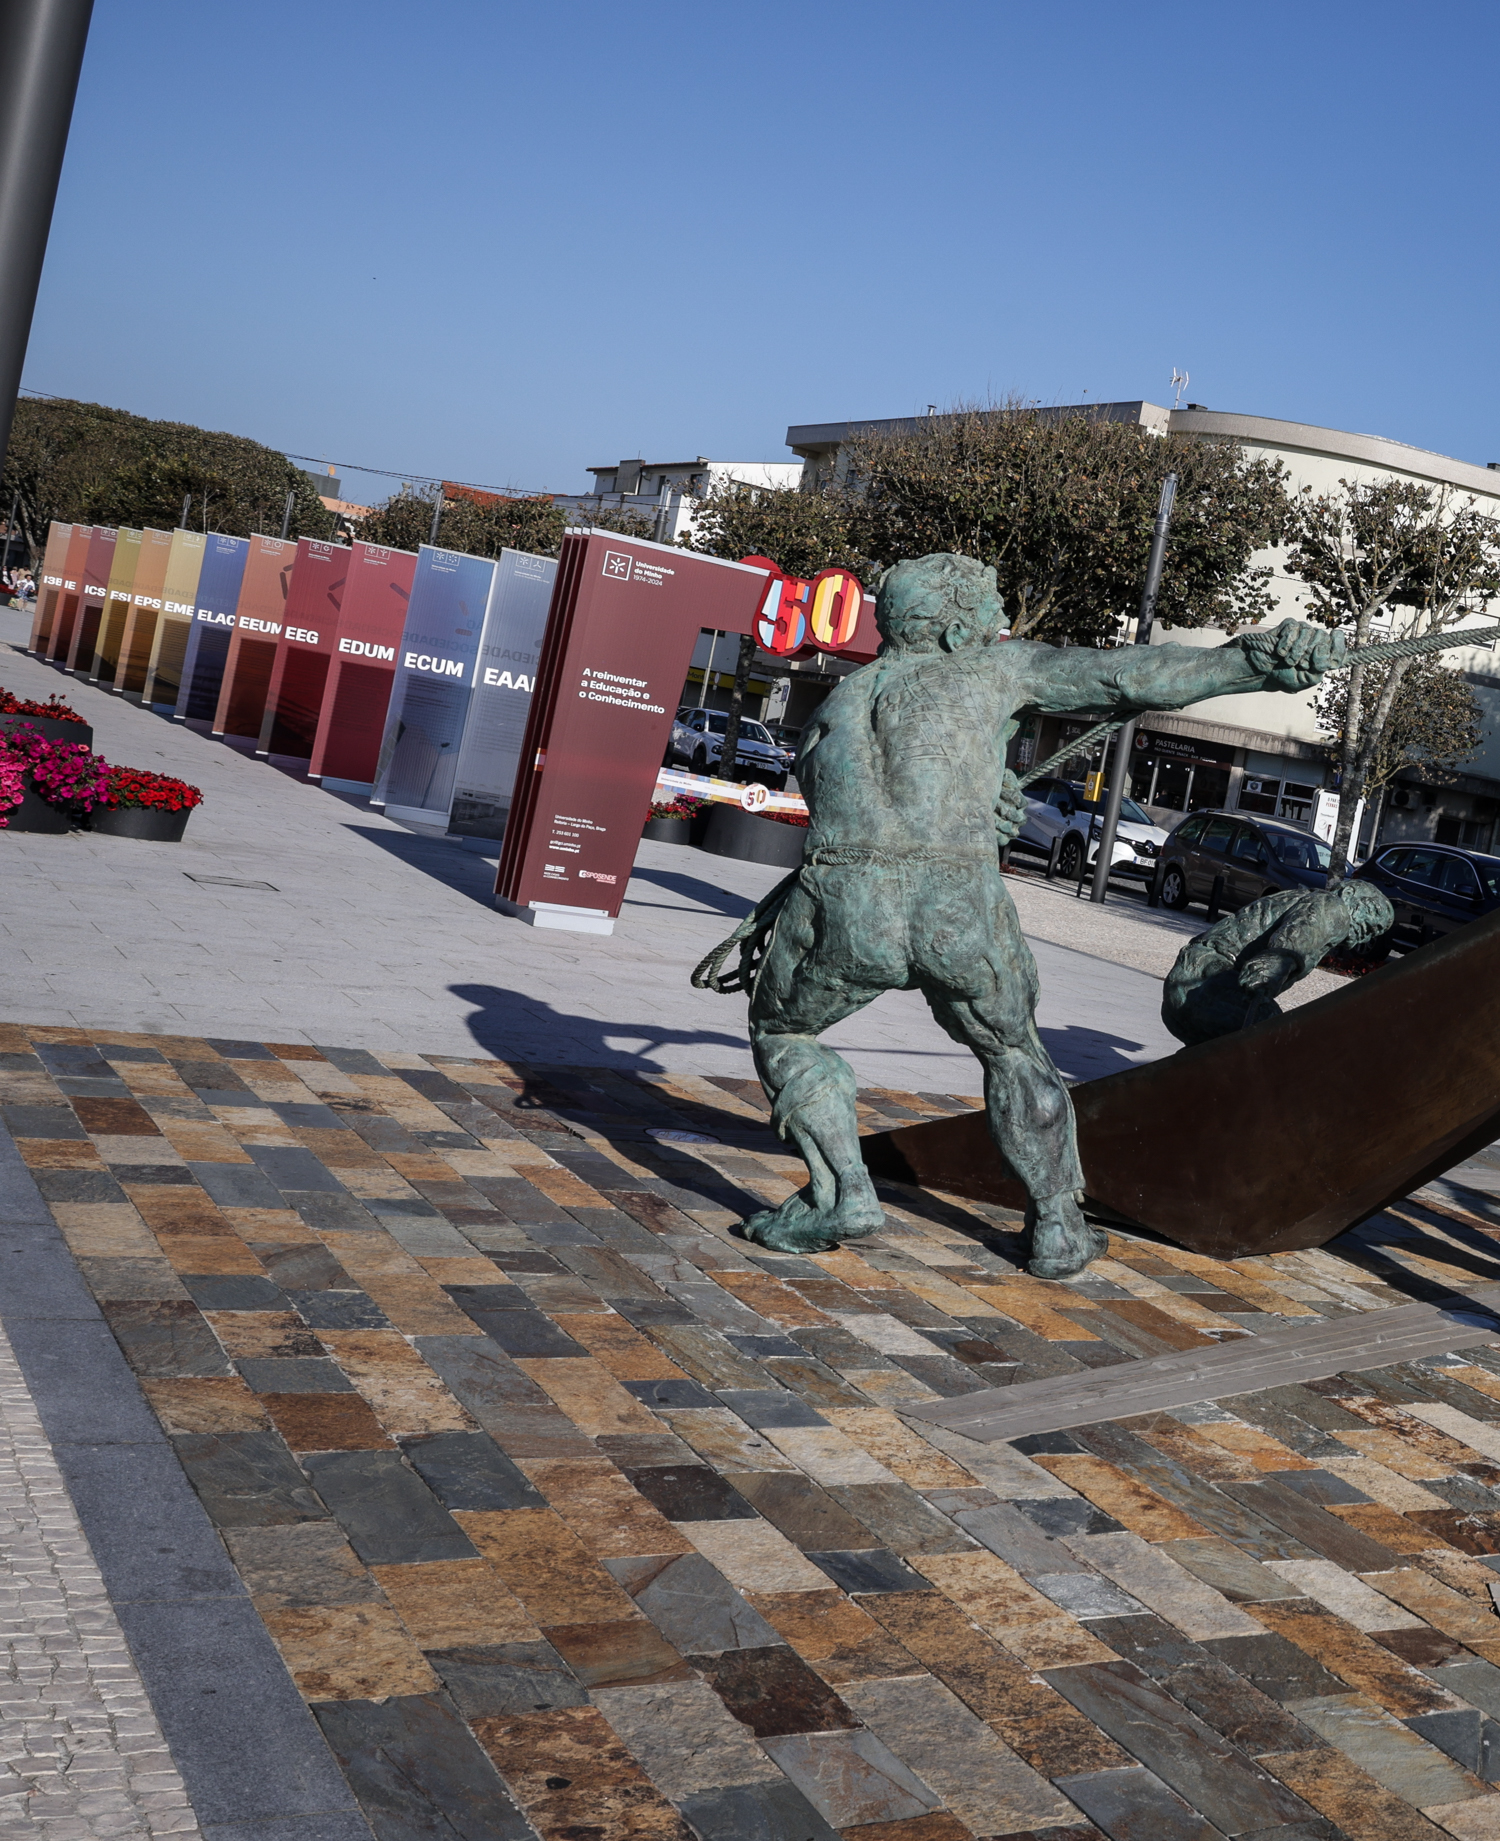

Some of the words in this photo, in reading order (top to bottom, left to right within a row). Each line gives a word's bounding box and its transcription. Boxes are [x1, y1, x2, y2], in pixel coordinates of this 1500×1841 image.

[634, 567, 643, 575] do
[643, 569, 663, 579] Minho
[635, 560, 675, 576] Universidade
[64, 579, 77, 591] IE
[633, 574, 663, 586] 1974-2024
[84, 584, 107, 597] ICS
[133, 594, 162, 609] EPS
[758, 574, 861, 653] 50
[284, 626, 319, 645] EEG
[338, 637, 395, 662] EDUM
[403, 651, 464, 678] ECUM
[582, 667, 591, 677] A
[592, 671, 648, 688] reinventar
[580, 679, 588, 687] a
[589, 680, 642, 698] Educação
[642, 692, 651, 700] e
[588, 691, 665, 714] Conhecimento
[1155, 738, 1195, 753] PASTELARIA
